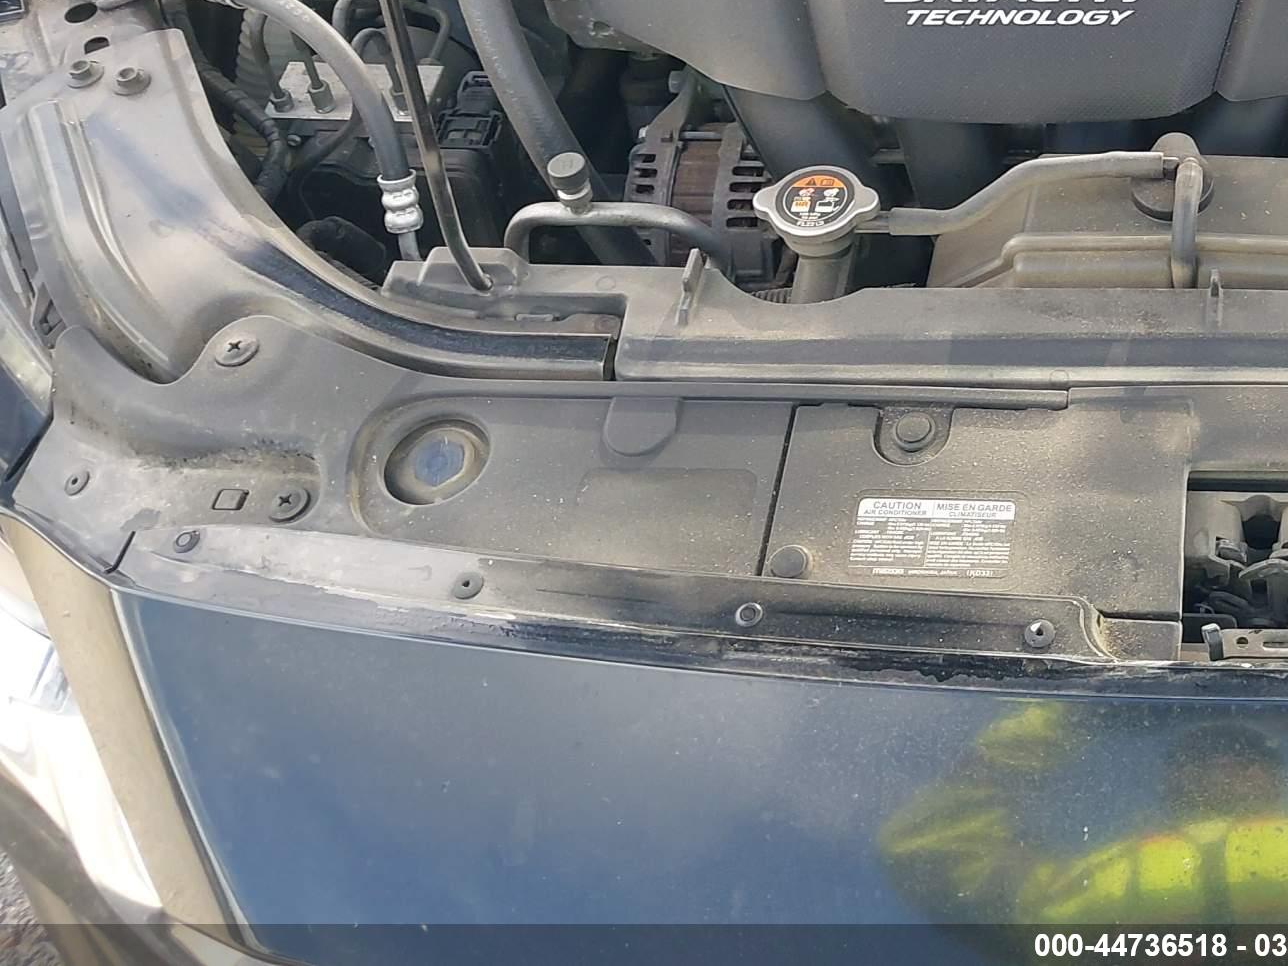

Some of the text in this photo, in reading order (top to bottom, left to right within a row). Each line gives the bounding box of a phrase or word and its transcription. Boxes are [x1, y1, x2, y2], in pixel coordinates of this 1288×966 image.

[906, 9, 1135, 26] TECHNOLOGY
[873, 501, 922, 510] CAUTION
[936, 503, 1013, 512] MISE EN GARDE
